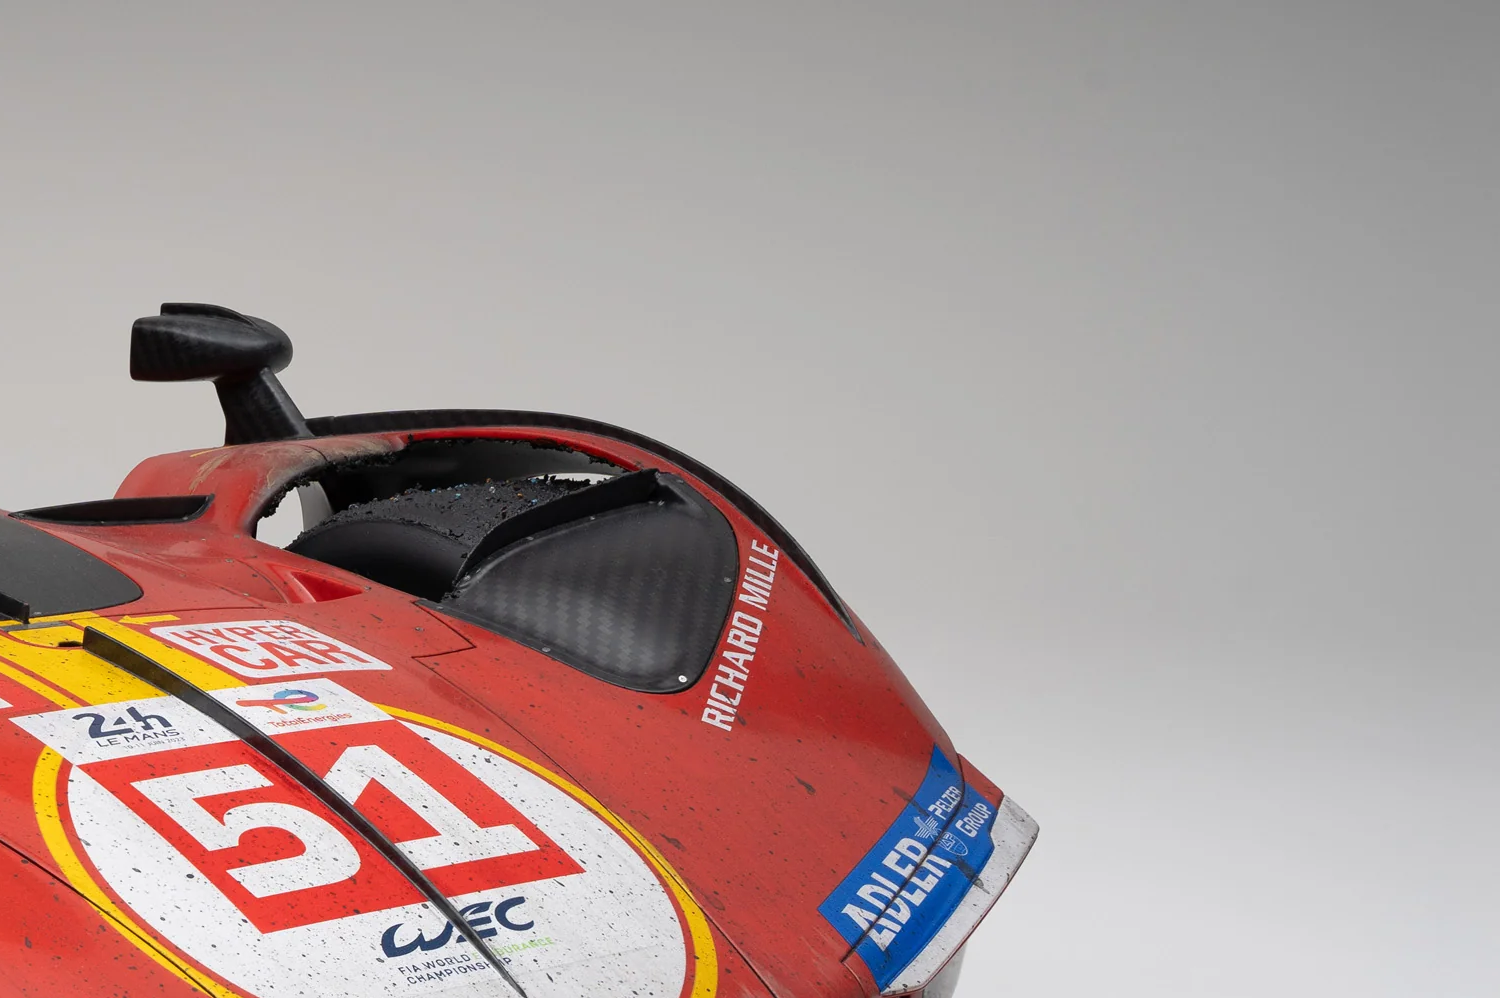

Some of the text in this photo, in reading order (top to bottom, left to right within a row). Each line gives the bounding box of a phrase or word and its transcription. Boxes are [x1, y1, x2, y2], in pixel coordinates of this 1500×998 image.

[168, 624, 318, 646] HYPER
[701, 539, 780, 732] RICHARD MILLE
[209, 638, 371, 671] CAR
[268, 711, 353, 728] TotalEnergies
[96, 728, 180, 748] LE MANS
[928, 785, 961, 821] PELZER
[955, 802, 992, 838] GROUP
[130, 745, 541, 900] 51
[381, 895, 535, 958] WEC
[397, 936, 554, 977] FIA WORLD EDURANCE
